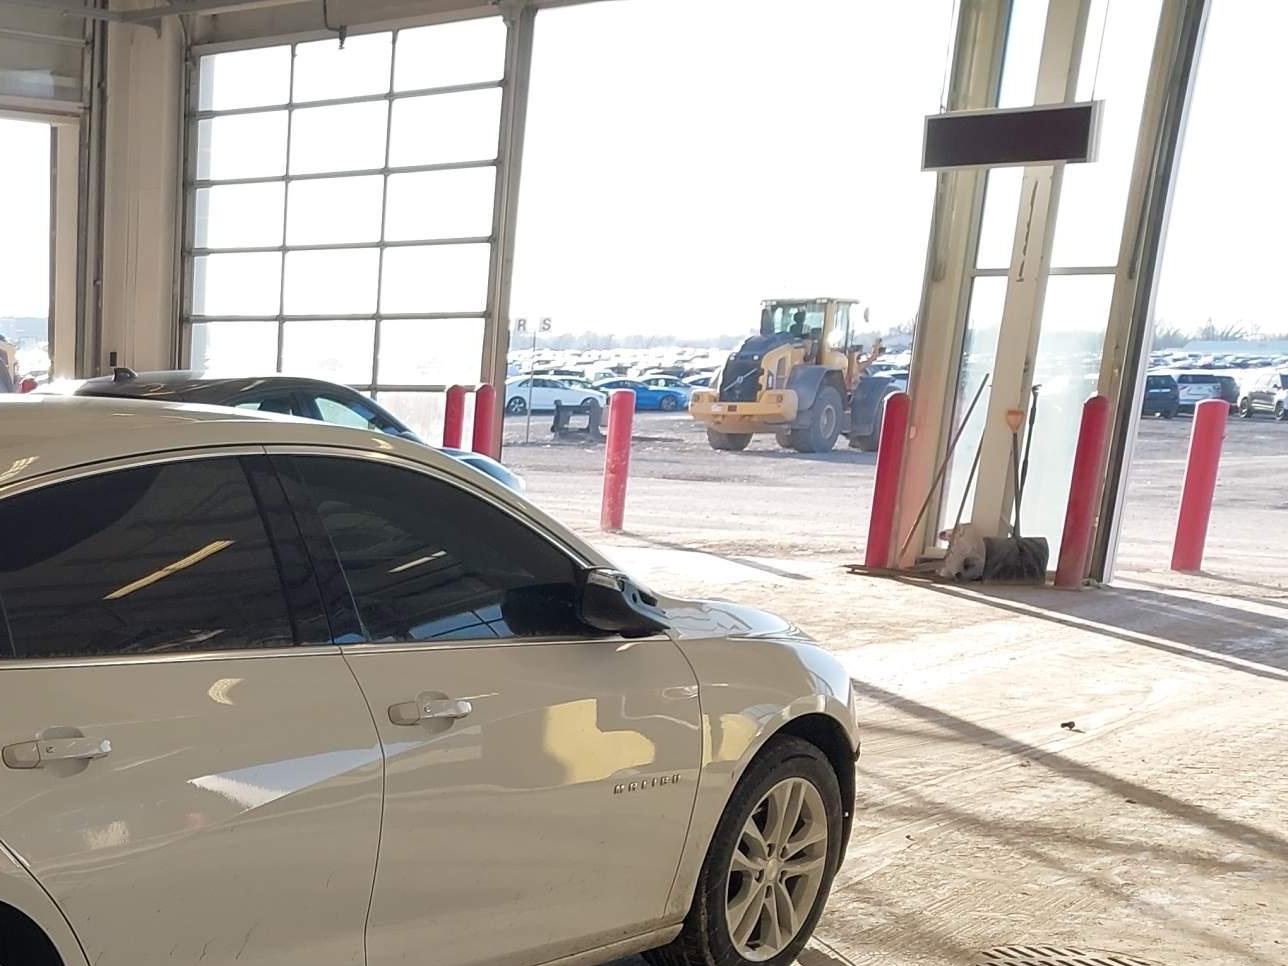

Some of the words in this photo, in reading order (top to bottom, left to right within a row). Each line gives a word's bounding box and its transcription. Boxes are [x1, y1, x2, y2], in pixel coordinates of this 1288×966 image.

[517, 318, 527, 331] R
[542, 318, 552, 331] S
[613, 774, 681, 795] MALIBU
